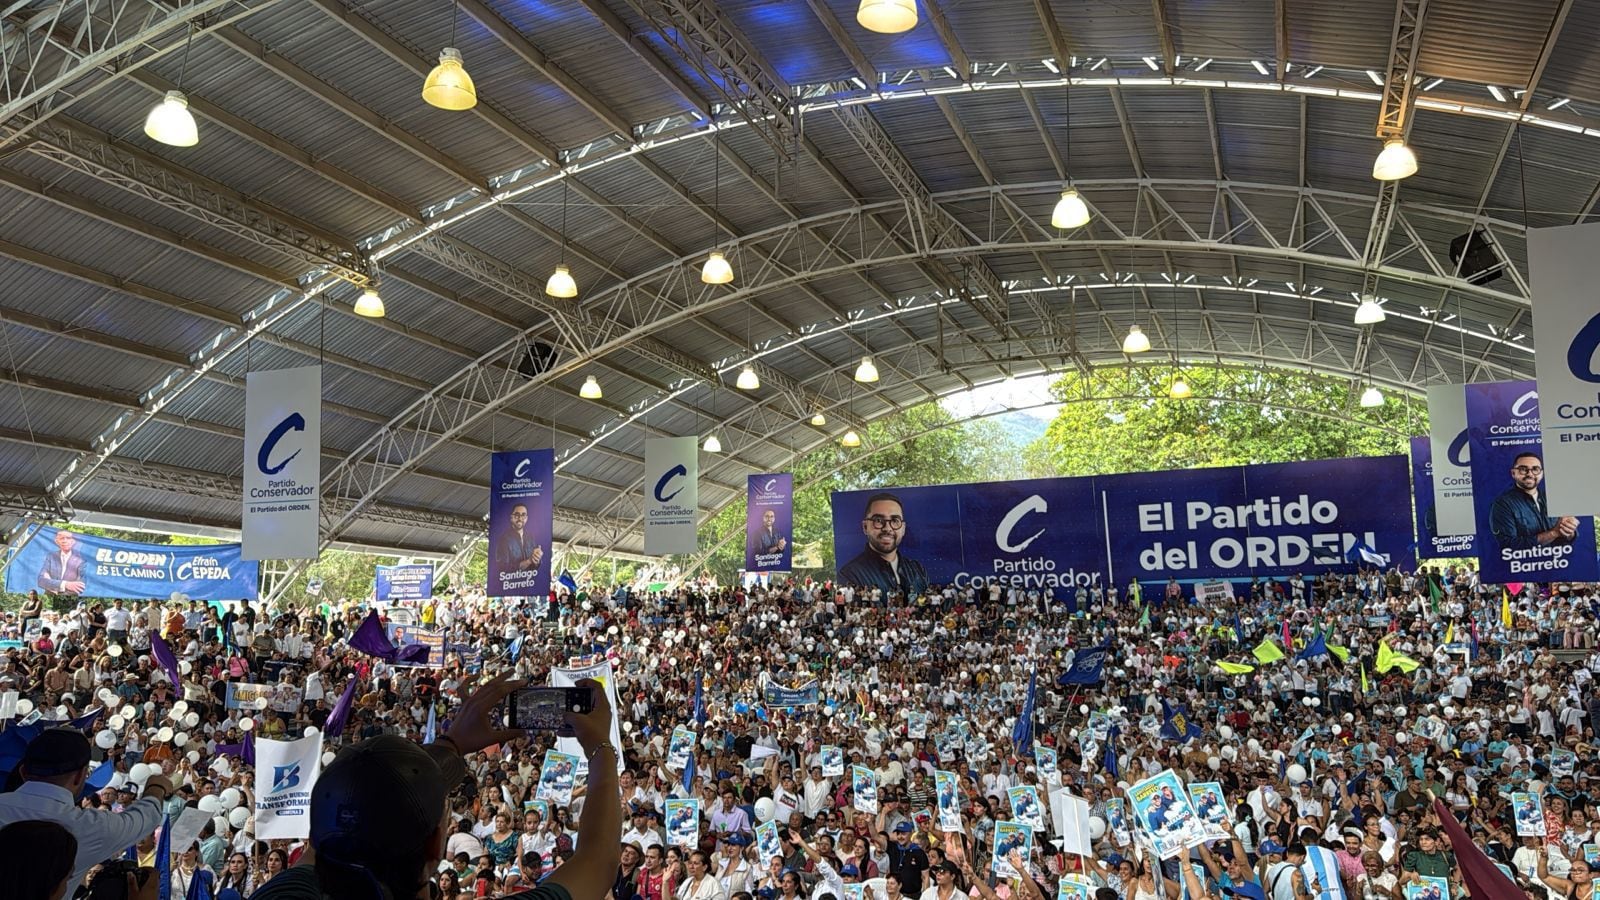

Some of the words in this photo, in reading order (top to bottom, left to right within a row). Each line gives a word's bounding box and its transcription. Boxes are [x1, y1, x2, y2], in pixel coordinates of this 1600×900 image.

[1560, 433, 1572, 442] El
[268, 479, 296, 488] Partido
[501, 481, 542, 490] Conservador
[250, 485, 315, 498] Conservador
[649, 508, 694, 517] Conservador
[1138, 501, 1174, 532] El
[1186, 494, 1338, 531] Partido
[1431, 534, 1474, 546] Santiago
[1436, 542, 1472, 553] Barreto
[1501, 543, 1573, 562] Santiago
[96, 548, 113, 562] EL
[114, 550, 167, 566] ORDEN
[754, 552, 783, 562] Santiago
[1139, 540, 1198, 570] del
[757, 558, 781, 567] Barreto
[993, 556, 1056, 572] Partido
[1510, 557, 1569, 574] Barreto
[96, 565, 109, 575] ES
[110, 566, 122, 576] EL
[123, 568, 165, 579] CAMINO
[499, 569, 538, 581] Santiago
[502, 578, 535, 590] Barreto
[263, 794, 289, 803] SOMOS
